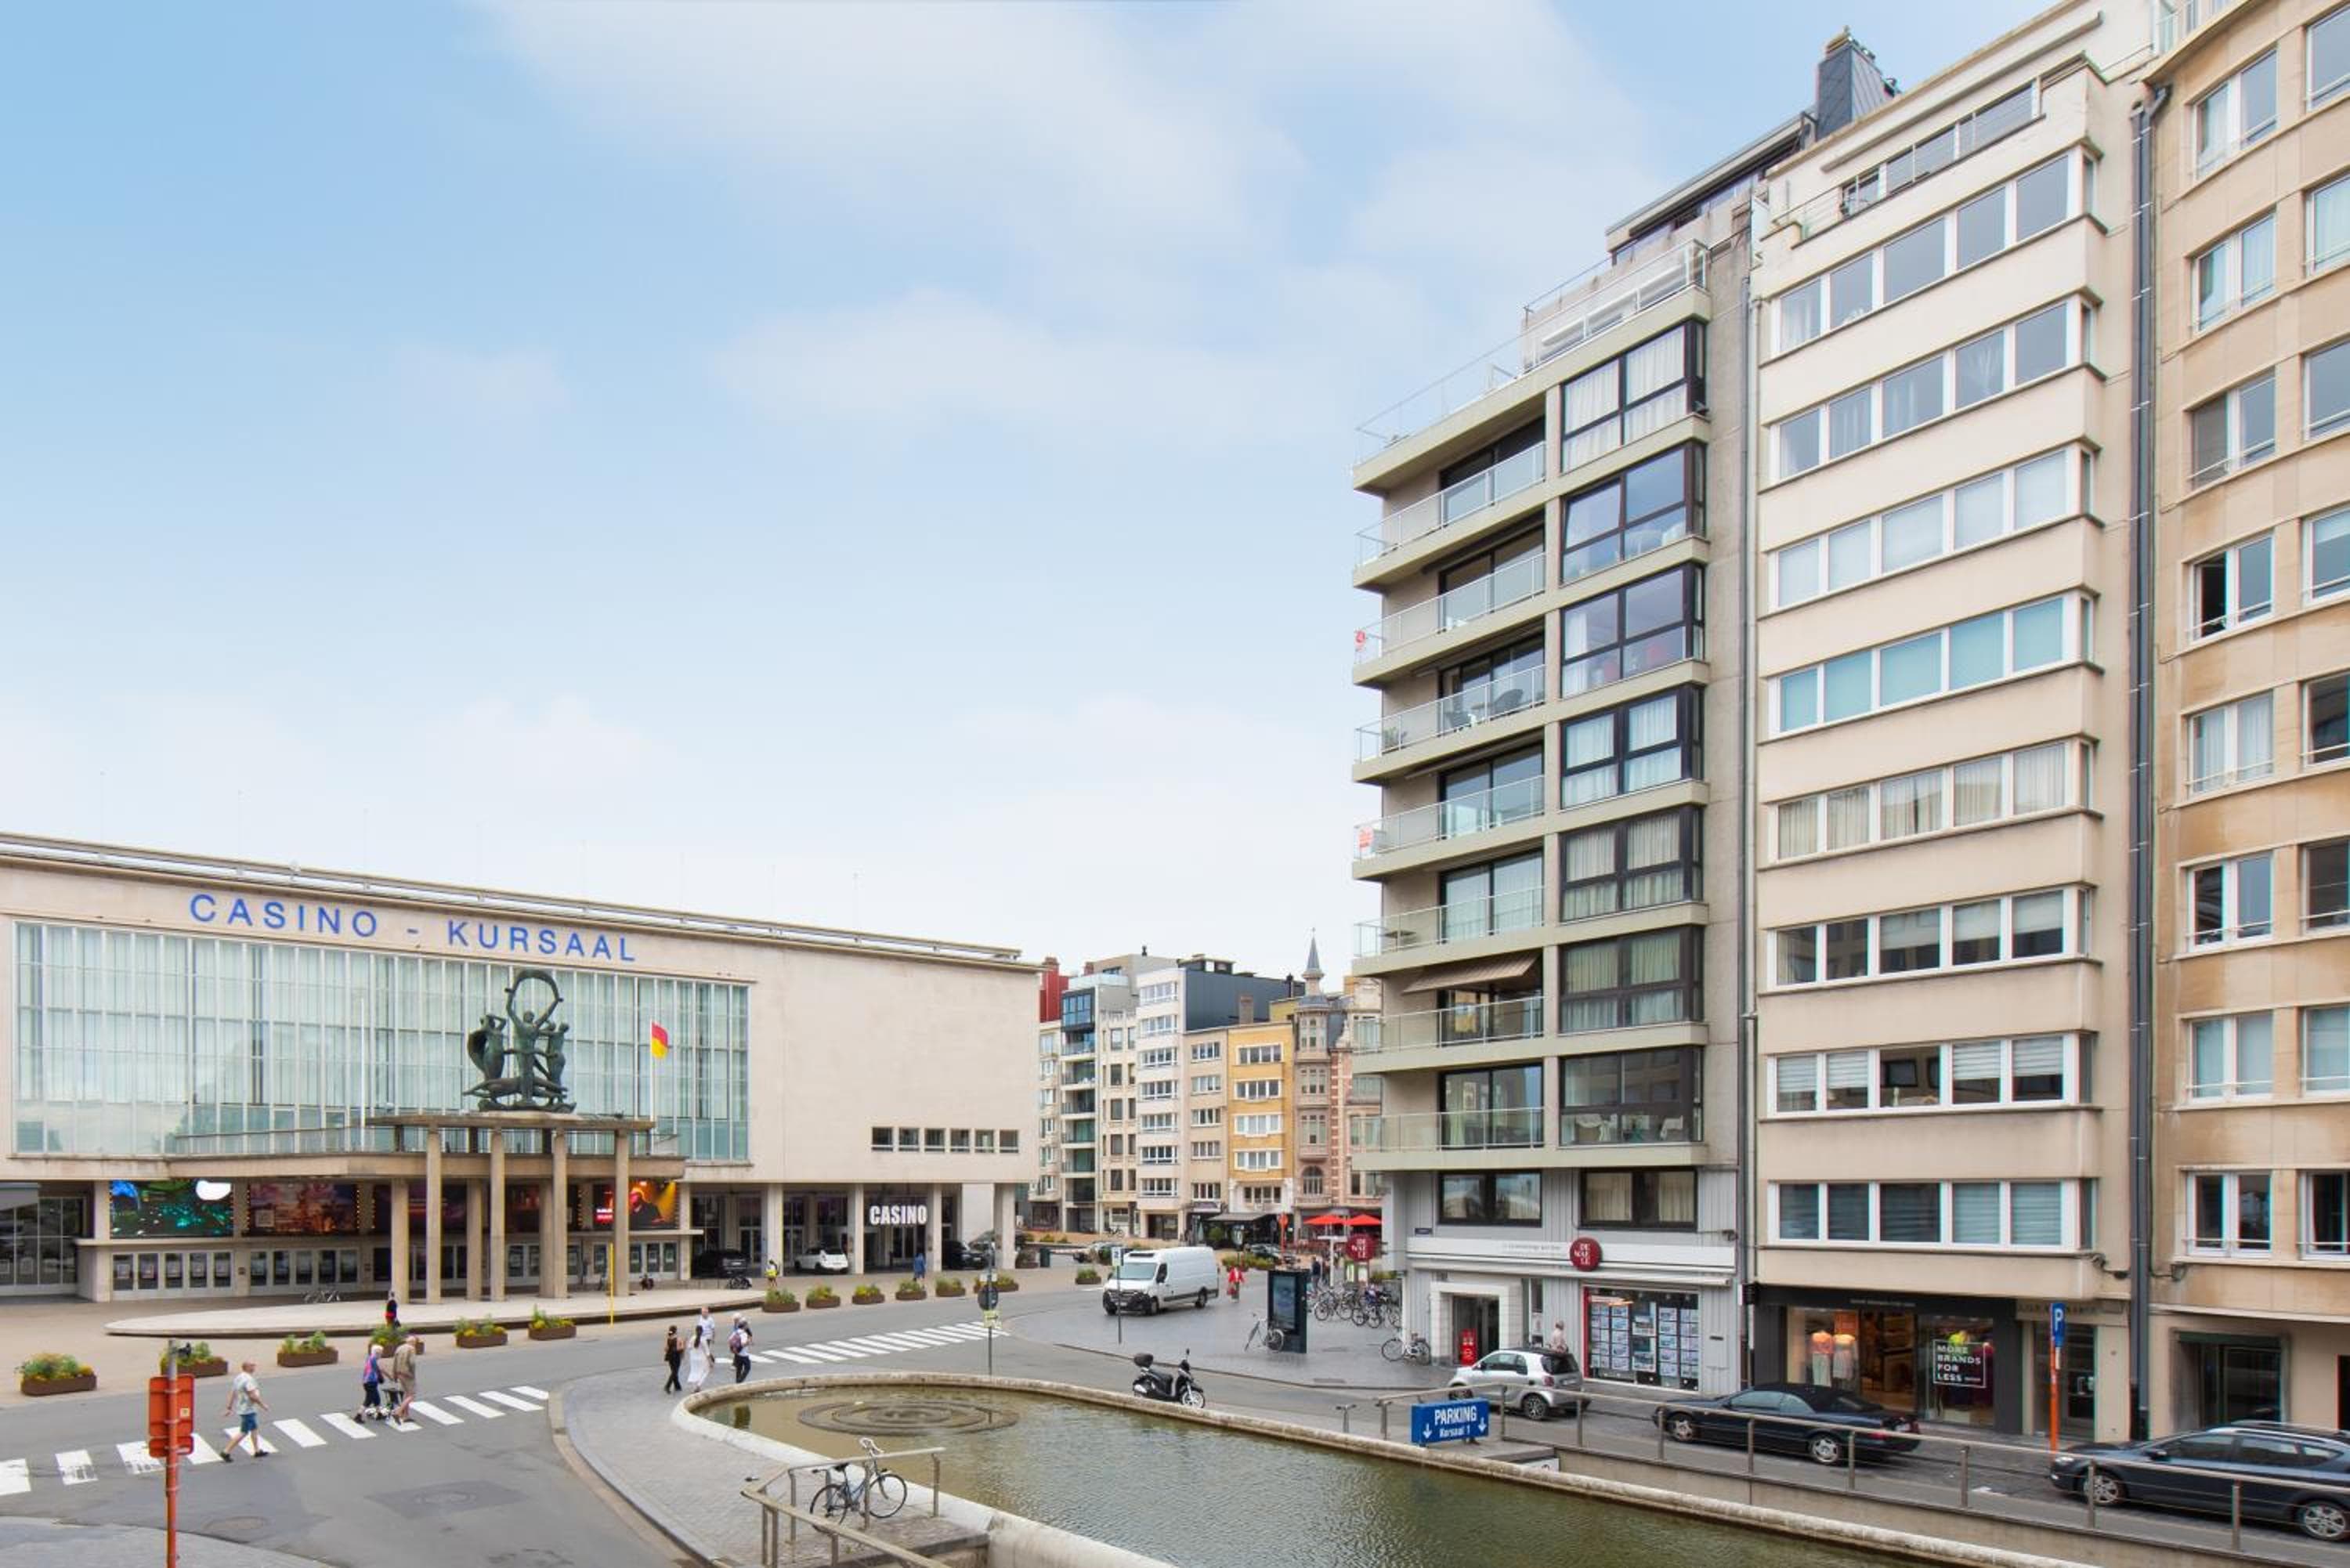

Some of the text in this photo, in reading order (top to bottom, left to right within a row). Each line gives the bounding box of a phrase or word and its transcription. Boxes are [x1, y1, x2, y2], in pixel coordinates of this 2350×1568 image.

[190, 894, 378, 938] CASINO
[447, 919, 635, 961] KURSAAL
[870, 1205, 927, 1225] CASINO
[2055, 1308, 2064, 1331] P
[1937, 1345, 1968, 1353] MORE
[1937, 1354, 1980, 1364] BRANDS
[1937, 1364, 1958, 1372] FOR
[1937, 1373, 1961, 1382] LESS
[1434, 1405, 1477, 1425] PARKING
